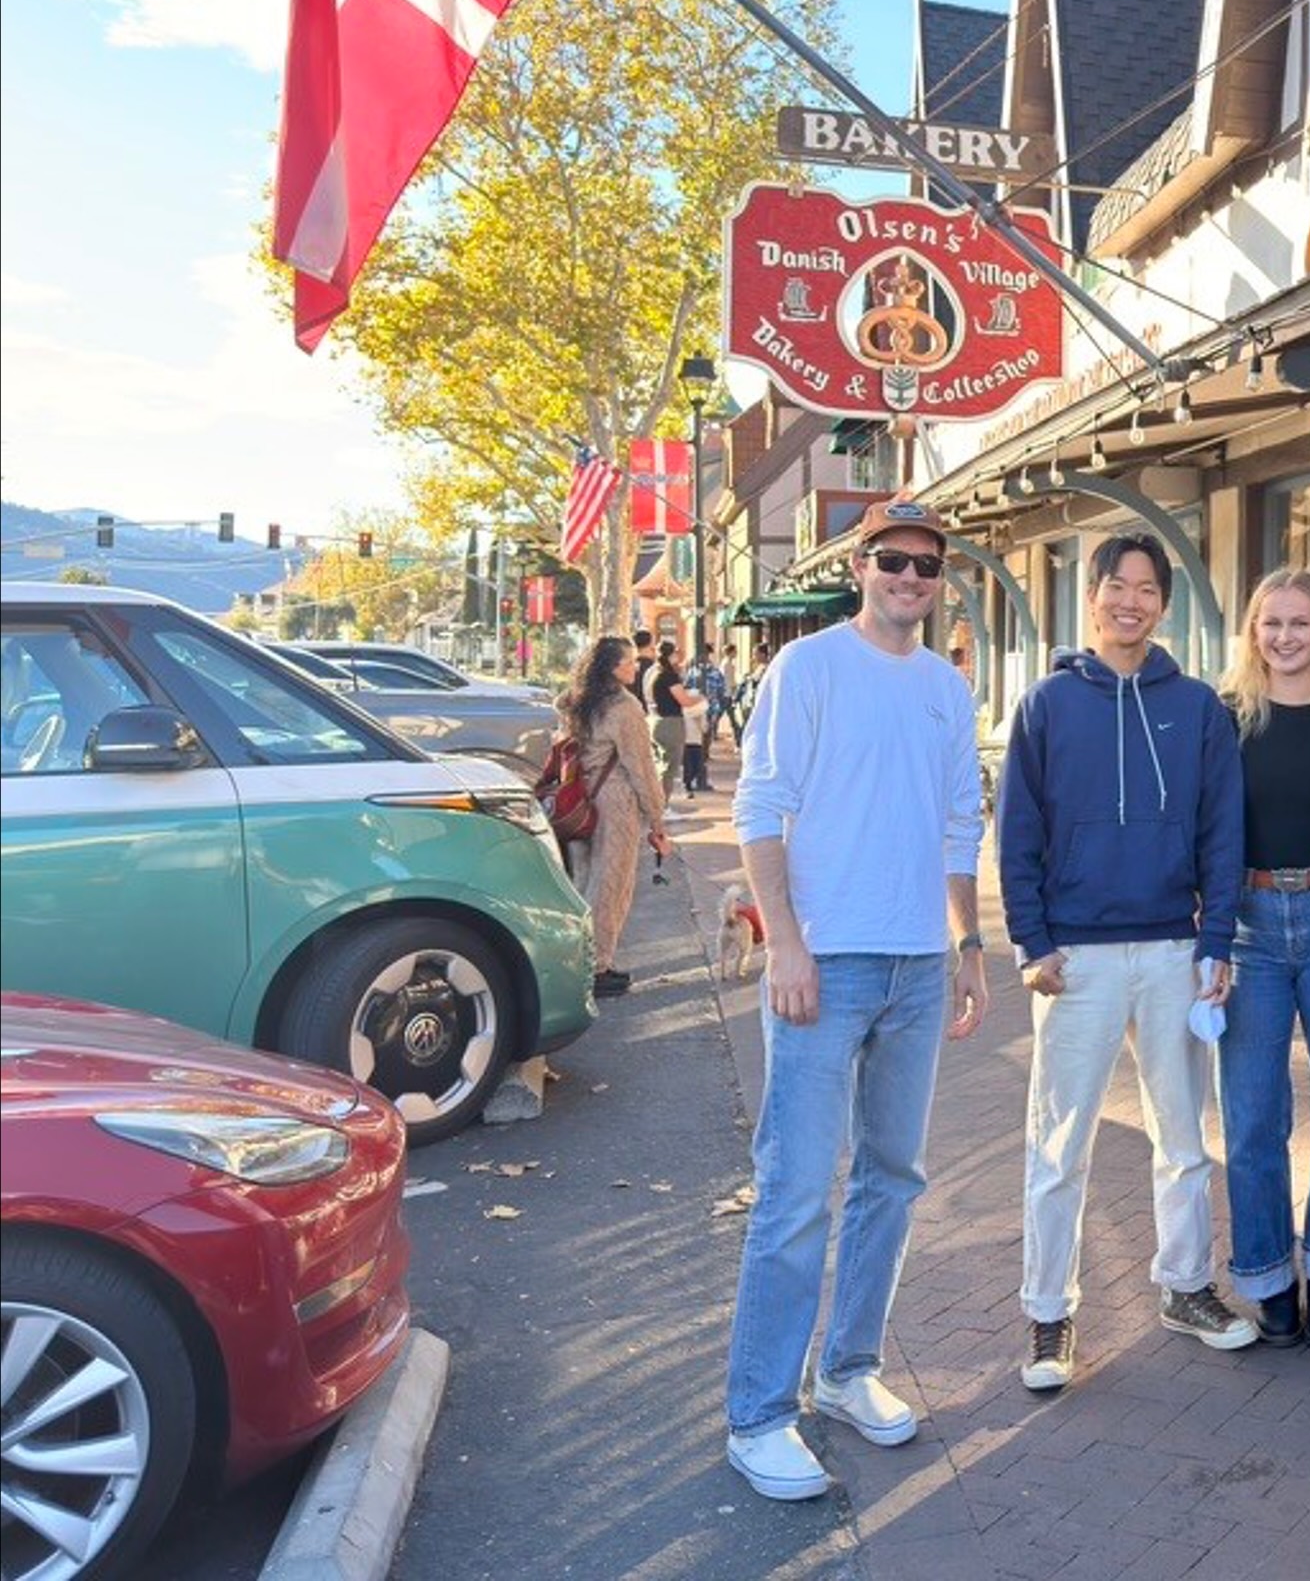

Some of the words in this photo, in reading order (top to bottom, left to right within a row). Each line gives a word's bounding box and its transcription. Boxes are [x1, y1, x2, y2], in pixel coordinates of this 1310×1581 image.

[837, 208, 964, 253] Olsen's
[756, 240, 850, 278] Danish
[959, 261, 1040, 293] Village
[752, 316, 829, 390] Bakery
[844, 374, 868, 401] &
[922, 348, 1040, 404] Coffeeshop
